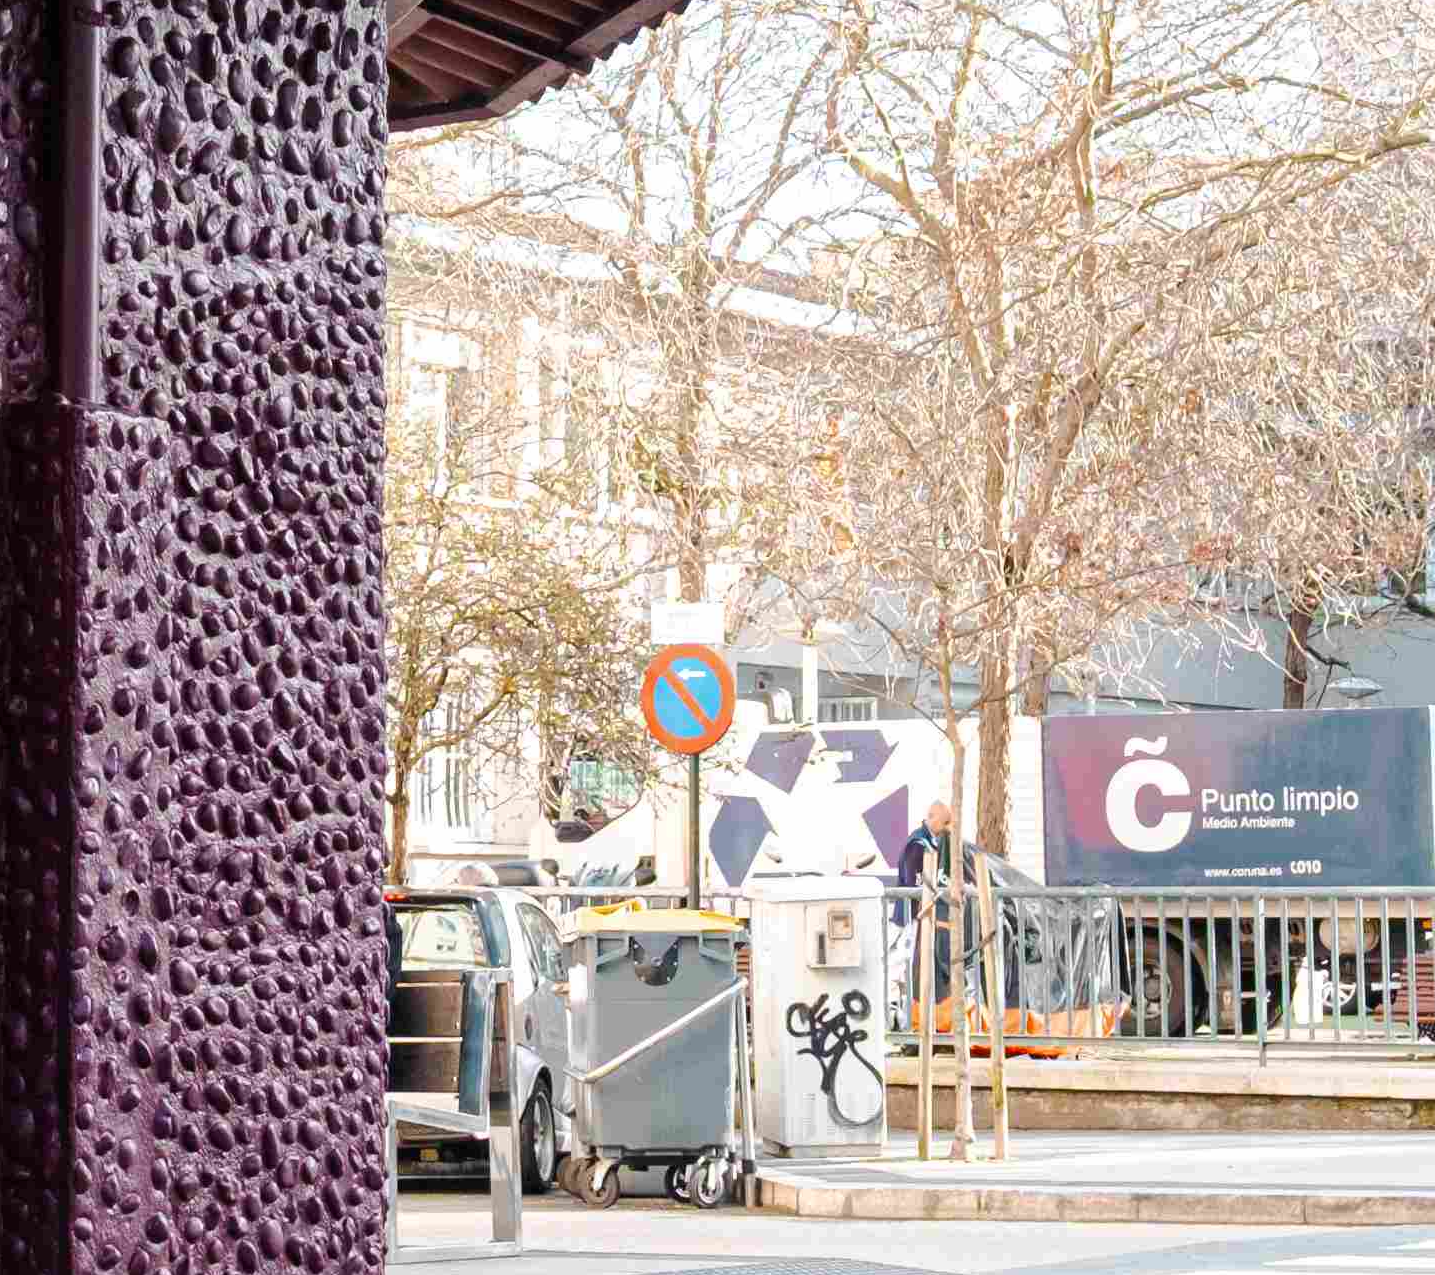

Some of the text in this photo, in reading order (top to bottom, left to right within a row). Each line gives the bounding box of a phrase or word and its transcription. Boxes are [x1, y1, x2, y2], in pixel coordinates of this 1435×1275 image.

[1201, 784, 1360, 817] Punto limpio
[1202, 815, 1296, 829] Medio Ambiente
